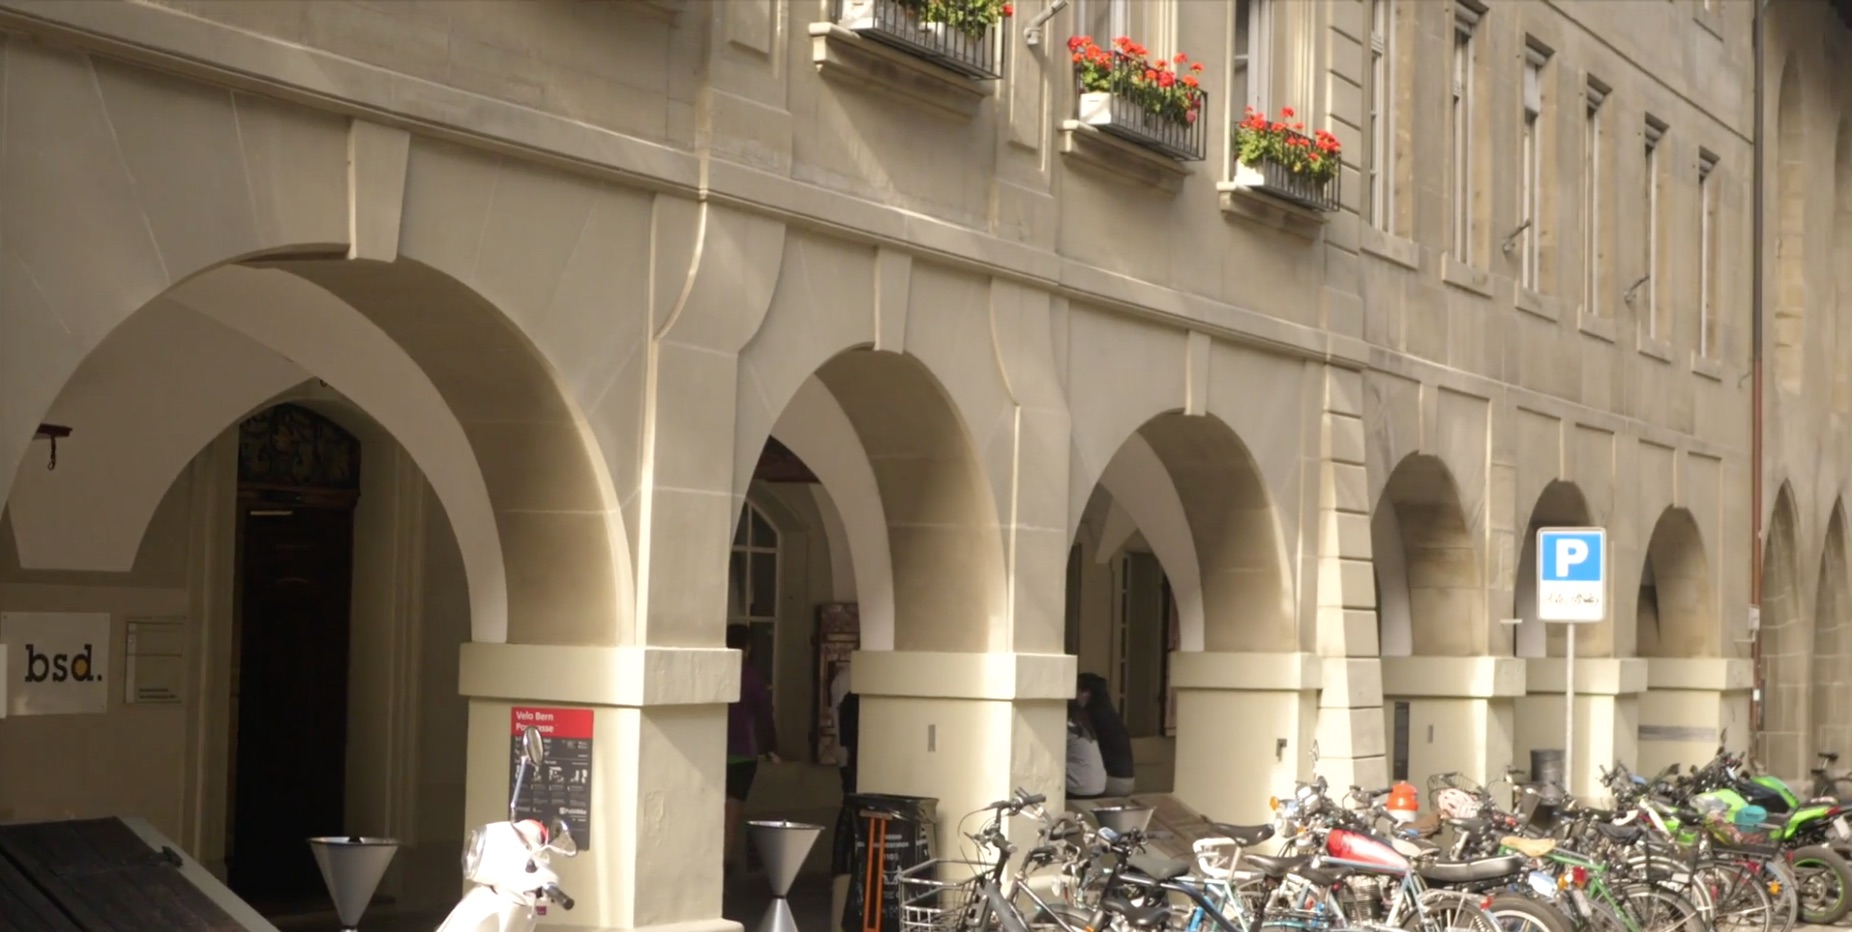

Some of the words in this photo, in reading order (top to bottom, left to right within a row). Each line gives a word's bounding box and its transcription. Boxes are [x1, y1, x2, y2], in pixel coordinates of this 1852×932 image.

[1555, 538, 1589, 578] P
[25, 644, 103, 682] bsd.
[515, 711, 534, 720] Velo
[535, 711, 554, 721] Bern
